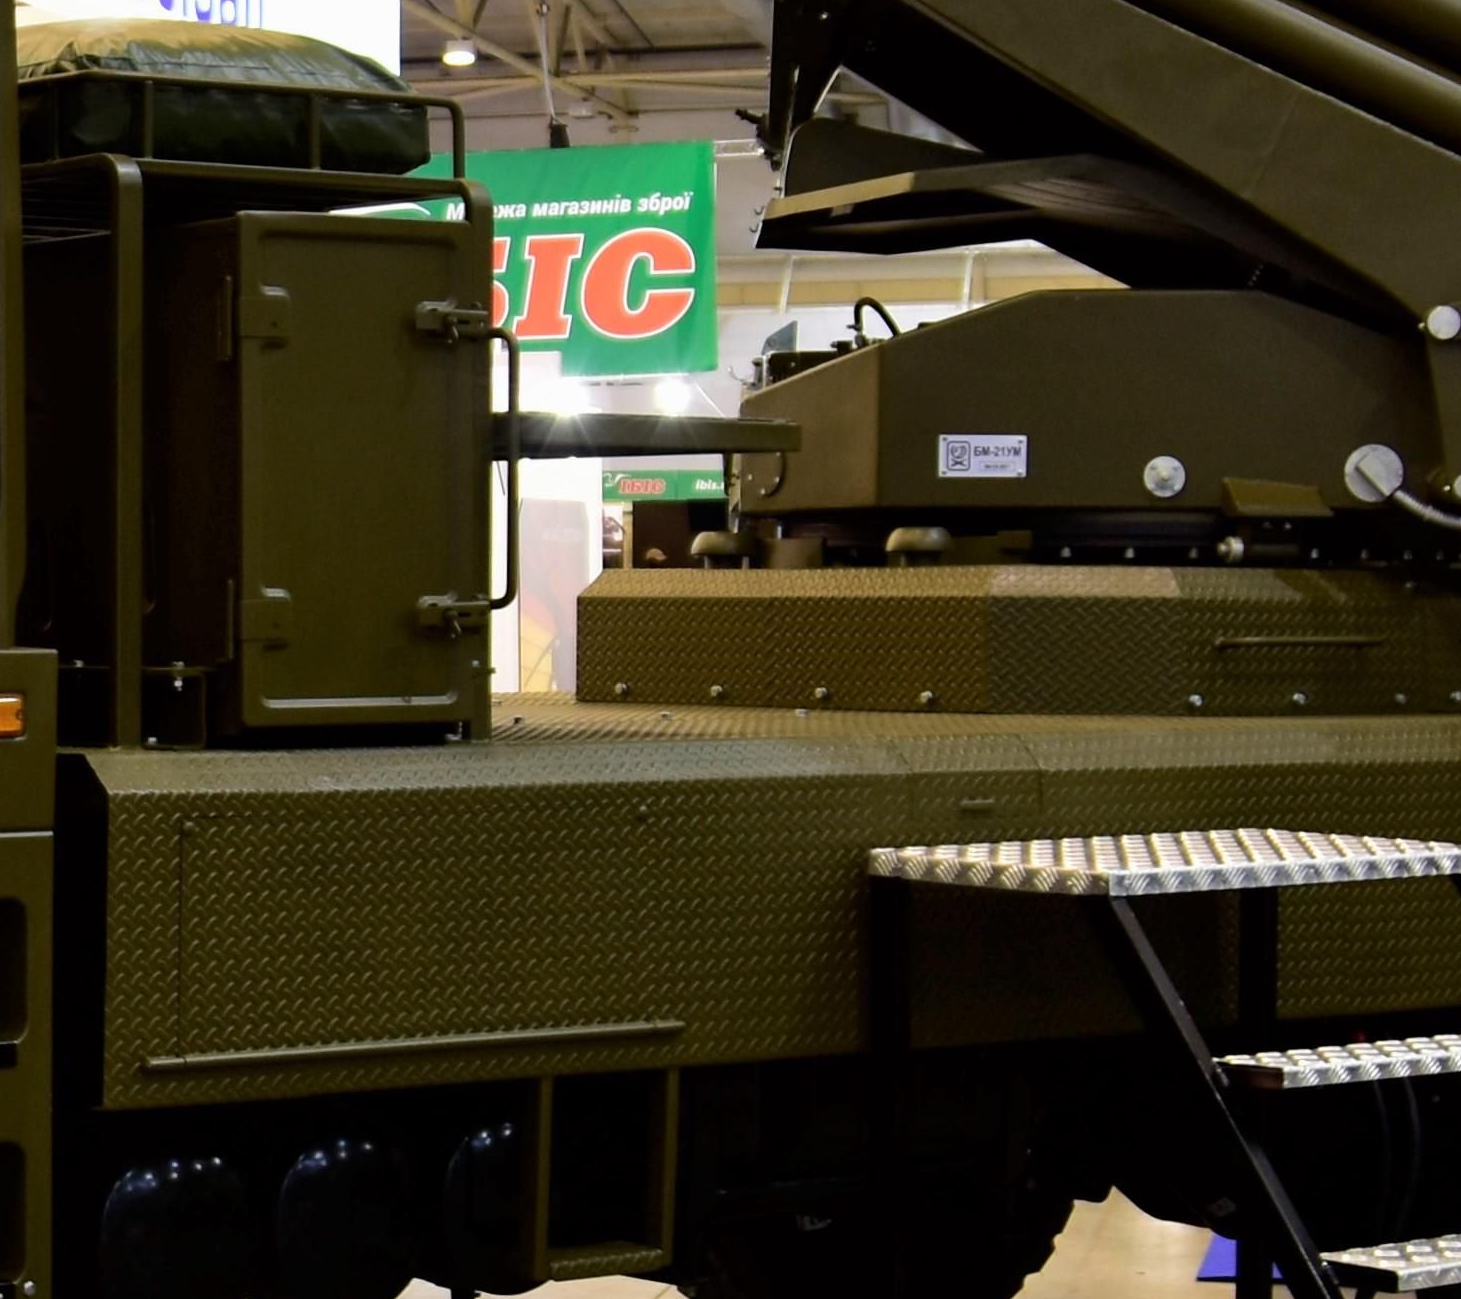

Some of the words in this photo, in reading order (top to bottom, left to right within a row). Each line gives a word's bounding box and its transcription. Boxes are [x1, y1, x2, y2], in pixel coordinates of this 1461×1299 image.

[532, 194, 632, 218] магазинів
[638, 191, 694, 216] зброї
[973, 445, 1022, 458] БМ-21УМ
